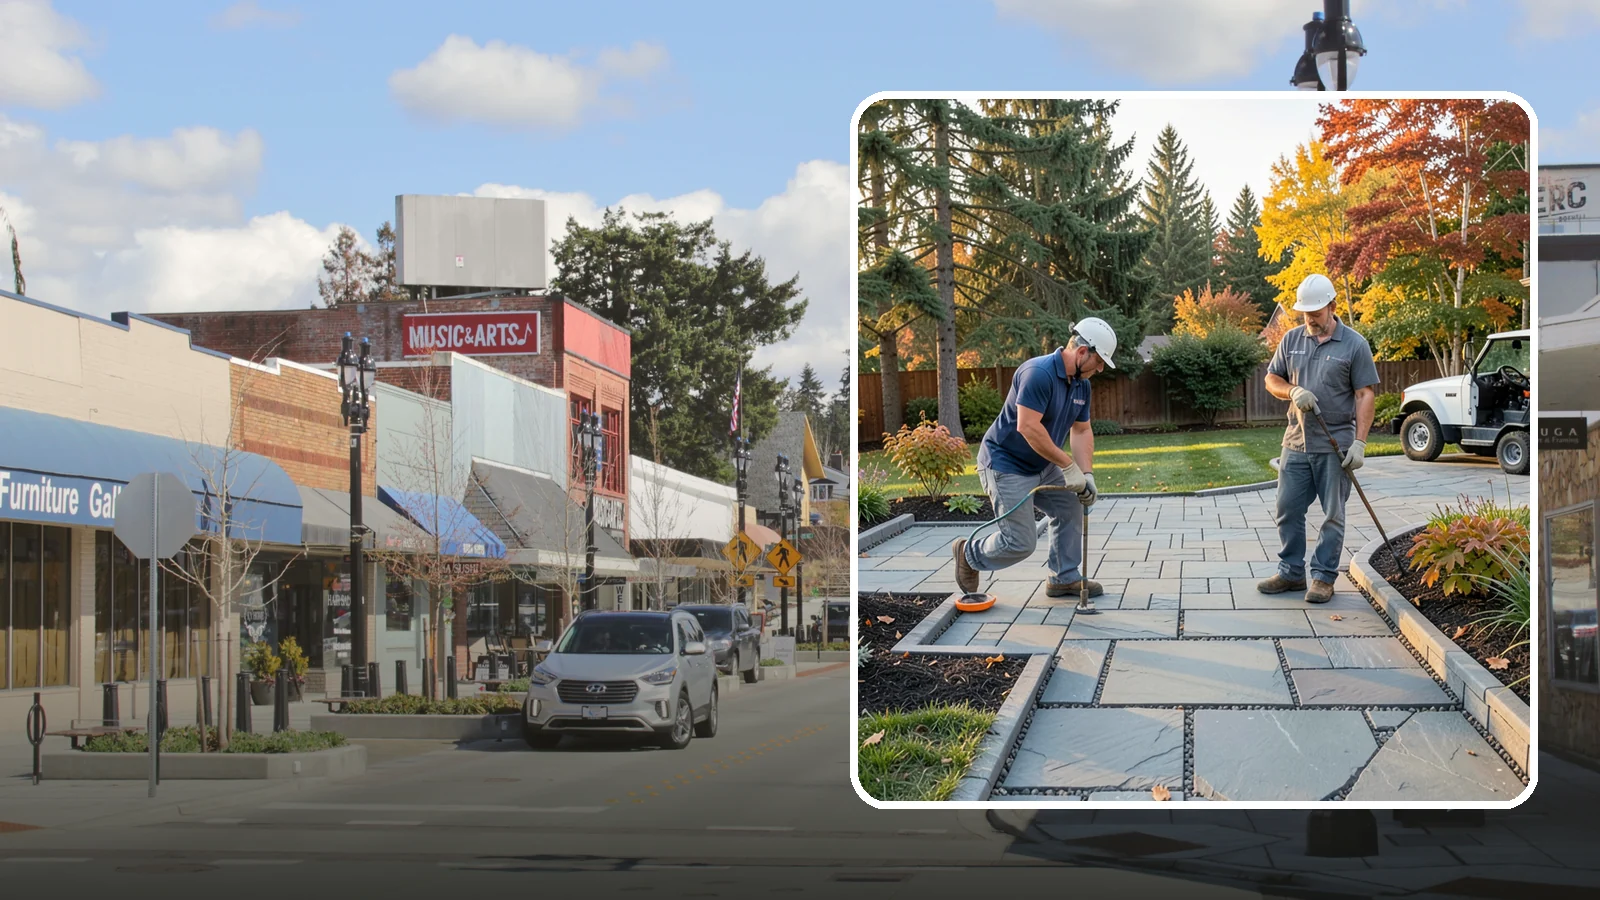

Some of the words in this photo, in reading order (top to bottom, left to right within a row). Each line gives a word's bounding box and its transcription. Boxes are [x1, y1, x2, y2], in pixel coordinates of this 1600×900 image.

[1540, 427, 1577, 436] UGA
[0, 470, 79, 515] Furniture
[453, 563, 479, 574] SUSHI
